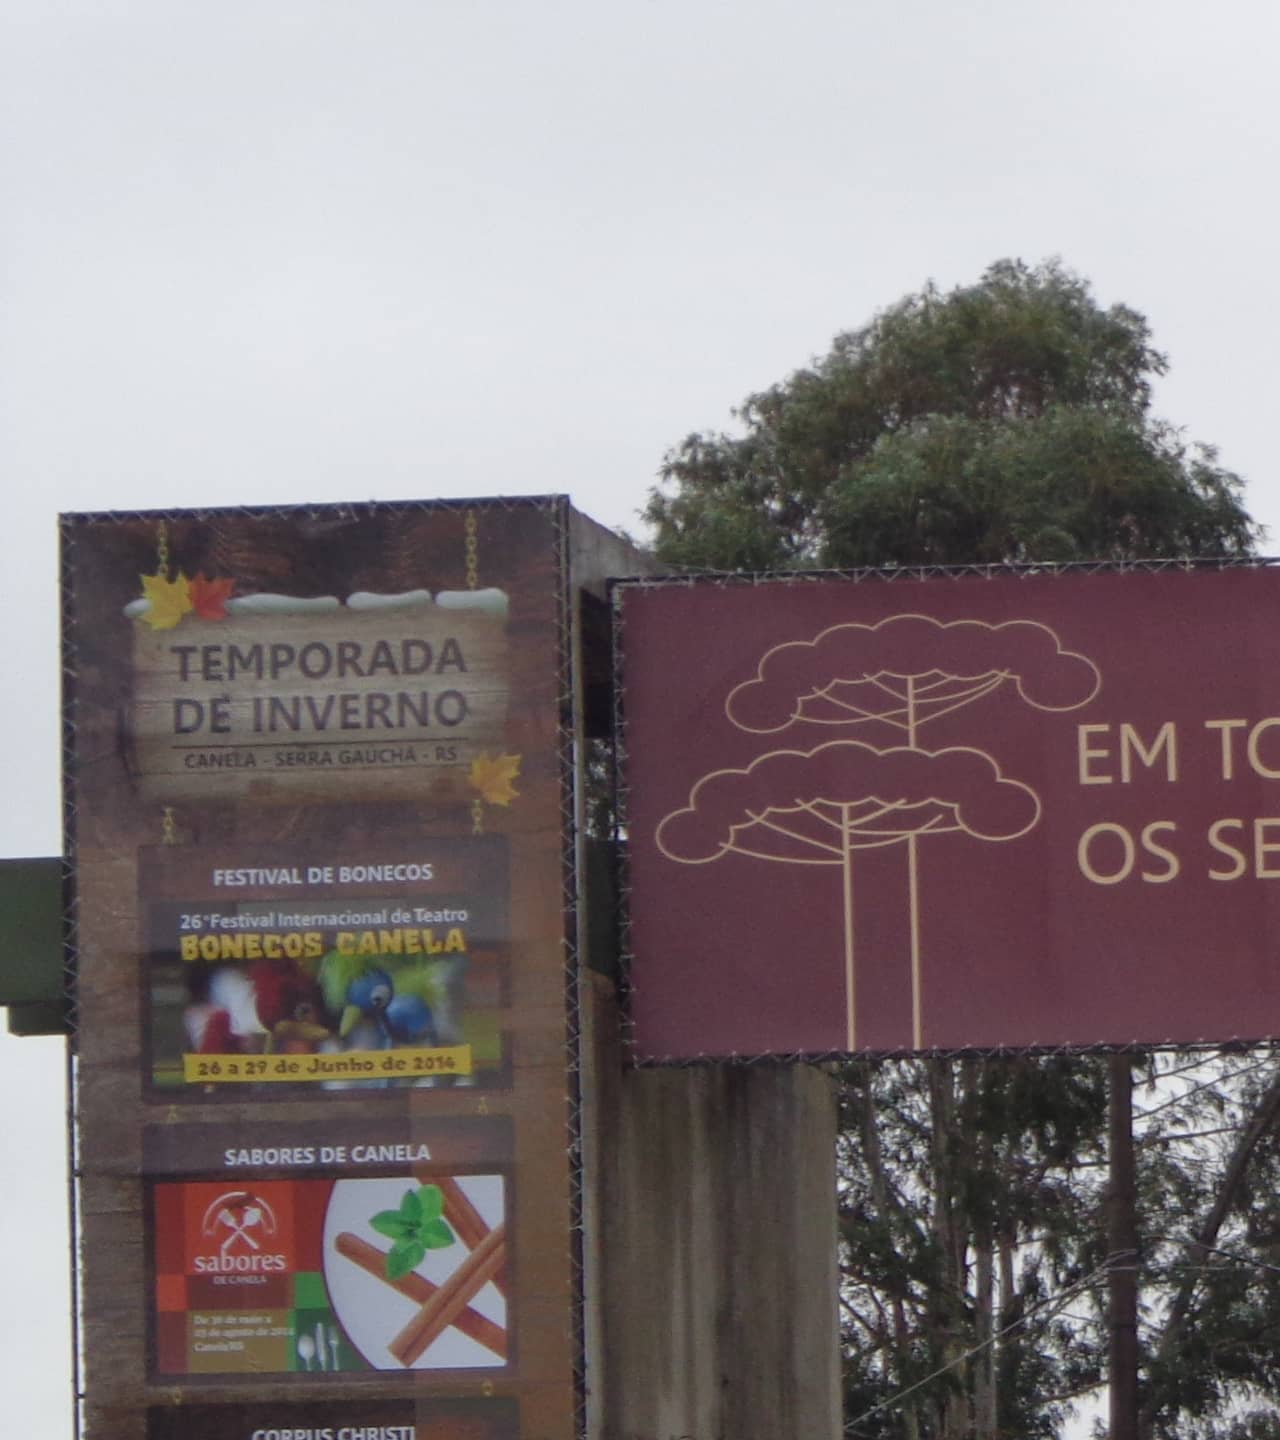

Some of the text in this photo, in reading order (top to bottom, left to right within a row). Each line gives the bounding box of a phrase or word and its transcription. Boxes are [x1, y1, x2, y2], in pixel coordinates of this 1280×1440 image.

[171, 637, 468, 681] TEMPORADA
[174, 690, 468, 734] DE INVERNO
[185, 753, 256, 769] CANELA
[275, 751, 332, 767] SERRA
[338, 748, 416, 765] GAUCHA
[435, 747, 457, 762] RS
[1077, 722, 1177, 785] EM
[1077, 821, 1180, 885] OS
[214, 864, 433, 886] FESTIVAL DE BONECOS
[278, 909, 387, 926] Internacional
[391, 908, 411, 924] de
[414, 906, 468, 923] Teatro
[180, 928, 466, 960] BONECOS CANELA
[198, 1061, 220, 1076] 26
[227, 1064, 238, 1075] a
[245, 1060, 266, 1075] 29
[278, 1059, 300, 1074] de
[307, 1057, 374, 1074] Junho
[383, 1057, 406, 1072] de
[225, 1145, 431, 1165] SABORES DE CANELA
[194, 1250, 286, 1273] sabores
